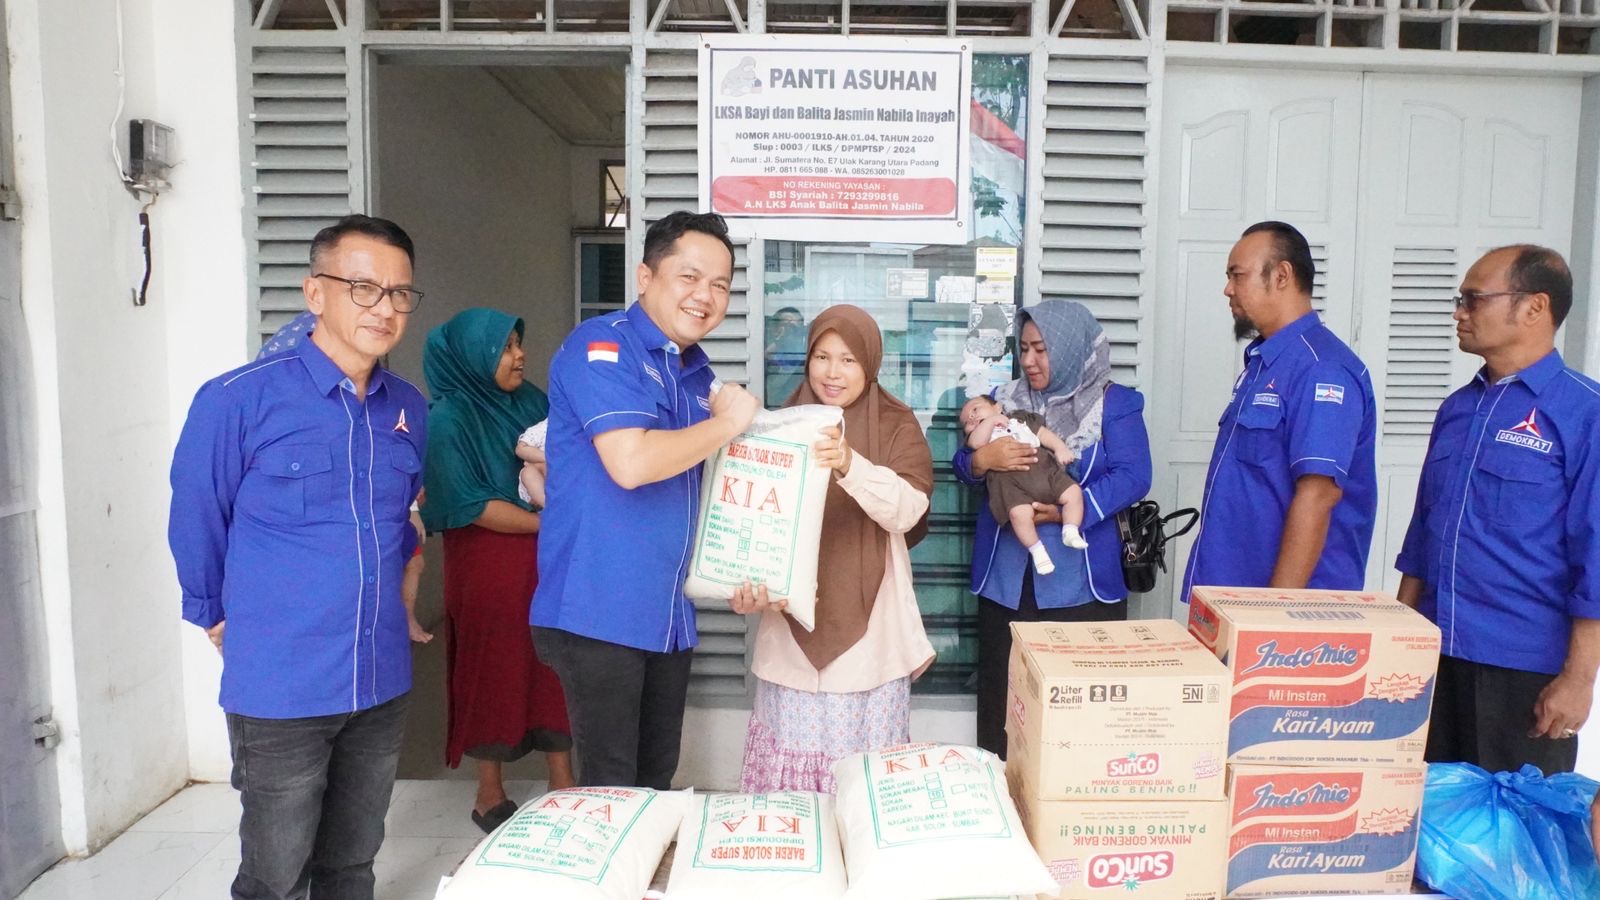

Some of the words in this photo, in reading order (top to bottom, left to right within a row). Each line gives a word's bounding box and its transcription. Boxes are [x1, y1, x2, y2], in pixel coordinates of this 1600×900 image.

[770, 68, 835, 89] PANTI
[843, 69, 937, 91] ASUHAN
[715, 106, 742, 119] LKSA
[745, 106, 770, 121] Bayi
[772, 106, 795, 119] dan
[797, 107, 831, 120] Balita
[833, 107, 874, 121] Jasmin
[877, 108, 914, 122] Nabila
[916, 109, 955, 124] Inayah
[736, 132, 770, 140] NOMOR
[880, 134, 909, 142] TAHUN
[780, 143, 803, 151] 0003
[841, 145, 885, 153] DPMPTSP
[730, 156, 757, 164] Alamat
[774, 156, 812, 164] Sumatera
[814, 157, 826, 165] No.
[840, 158, 857, 166] Ulak
[858, 158, 886, 167] Karang
[888, 159, 909, 167] Utara
[910, 159, 939, 168] Padang
[764, 166, 778, 174] HP.
[780, 166, 797, 174] 0811
[783, 181, 796, 189] NO
[798, 181, 841, 190] REKENING
[843, 182, 881, 190] YAYASAN
[769, 191, 787, 199] BSI
[790, 191, 829, 201] Syariah
[744, 201, 763, 209] A.N
[766, 201, 787, 209] LKS
[790, 201, 816, 209] Anak
[819, 201, 849, 210] Balita
[851, 202, 888, 210] Jasmin
[891, 203, 924, 211] Nabila
[1500, 433, 1548, 450] DEMOKRAT
[720, 475, 782, 514] KIA
[1049, 686, 1060, 704] 2
[1060, 685, 1083, 695] Liter
[1182, 686, 1204, 700] SNI
[1268, 689, 1285, 701] Mi
[1287, 689, 1327, 701] Instan
[1060, 695, 1083, 704] Refill
[1285, 709, 1309, 718] Rasa
[1272, 717, 1316, 734] Kari
[1316, 718, 1375, 738] Ayam
[885, 749, 966, 775] KIA
[1111, 758, 1157, 775] SunCo
[1065, 786, 1120, 794] PALING
[1129, 784, 1197, 794] BENING!!
[540, 796, 611, 822] KIA
[722, 815, 803, 834] KIA
[1060, 825, 1136, 836] BENING!!
[1147, 824, 1206, 834] PALING
[1265, 827, 1279, 837] Mi
[1281, 827, 1320, 837] Instan
[1073, 836, 1099, 846] BAIK
[1102, 835, 1148, 846] GORENG
[1149, 835, 1192, 845] MINYAK
[711, 847, 740, 860] SUPER
[742, 846, 772, 860] SOLOK
[774, 846, 805, 861] BAREH
[1280, 846, 1303, 854] Rasa
[1092, 853, 1170, 884] SunCo
[1267, 853, 1309, 869] Kari
[1310, 853, 1365, 872] Ayam
